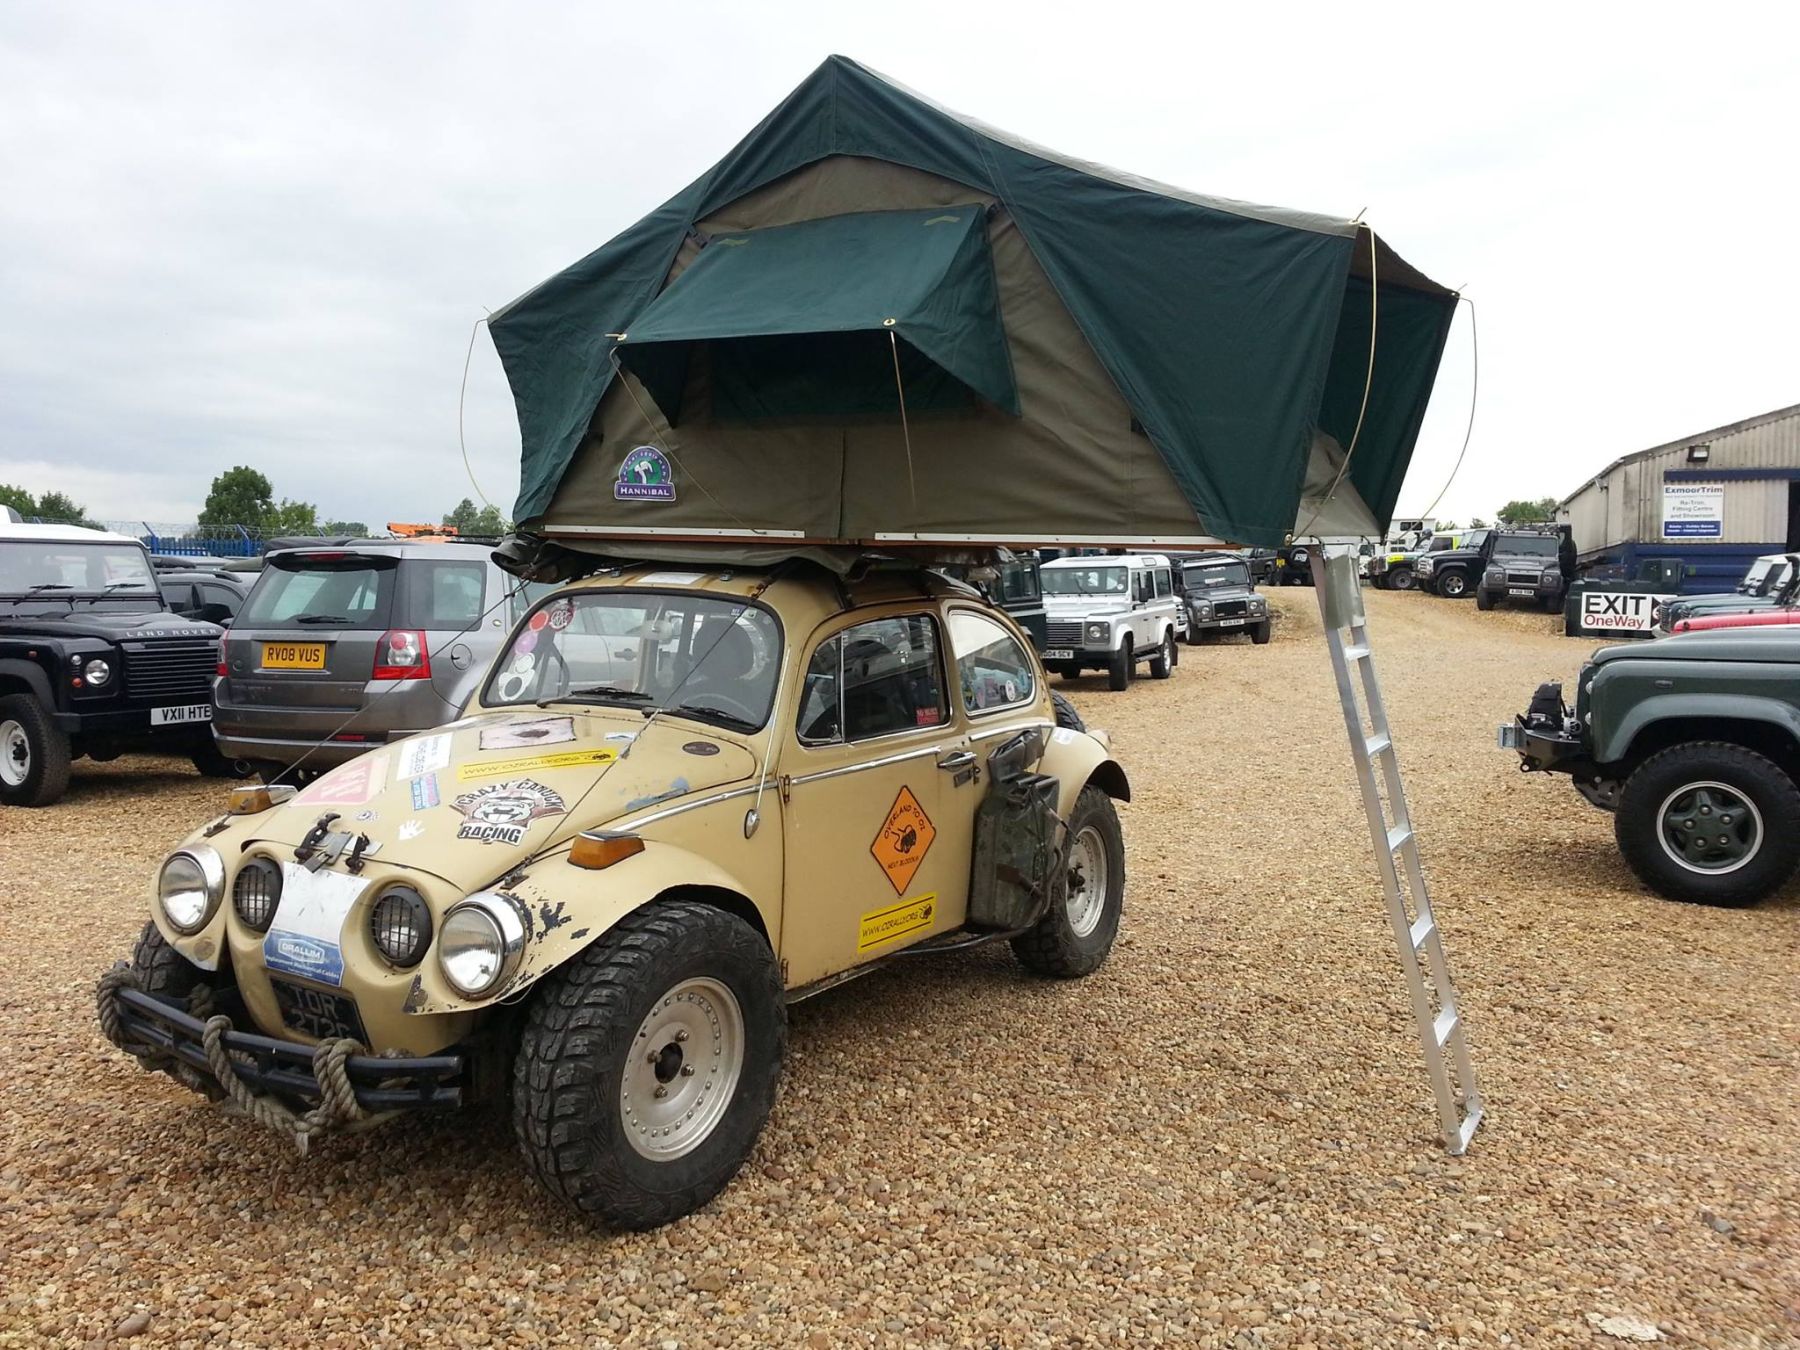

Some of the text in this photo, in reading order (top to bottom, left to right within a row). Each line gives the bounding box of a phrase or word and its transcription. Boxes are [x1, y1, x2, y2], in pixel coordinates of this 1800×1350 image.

[620, 487, 670, 496] HANNIBAL
[1665, 486, 1723, 494] ExmoorTrim
[1585, 594, 1647, 616] EXIT
[1584, 614, 1644, 630] OneWay
[172, 628, 217, 636] ROVER
[267, 647, 320, 662] RV08 VUS
[162, 705, 211, 721] VX11 HTE
[457, 782, 509, 806] CRAZY
[516, 781, 563, 808] CANUCK
[884, 804, 912, 839] OVERLAND
[913, 807, 920, 818] TO
[458, 825, 522, 843] RACING
[282, 943, 321, 958] DRALLIM
[290, 984, 339, 1019] TOR
